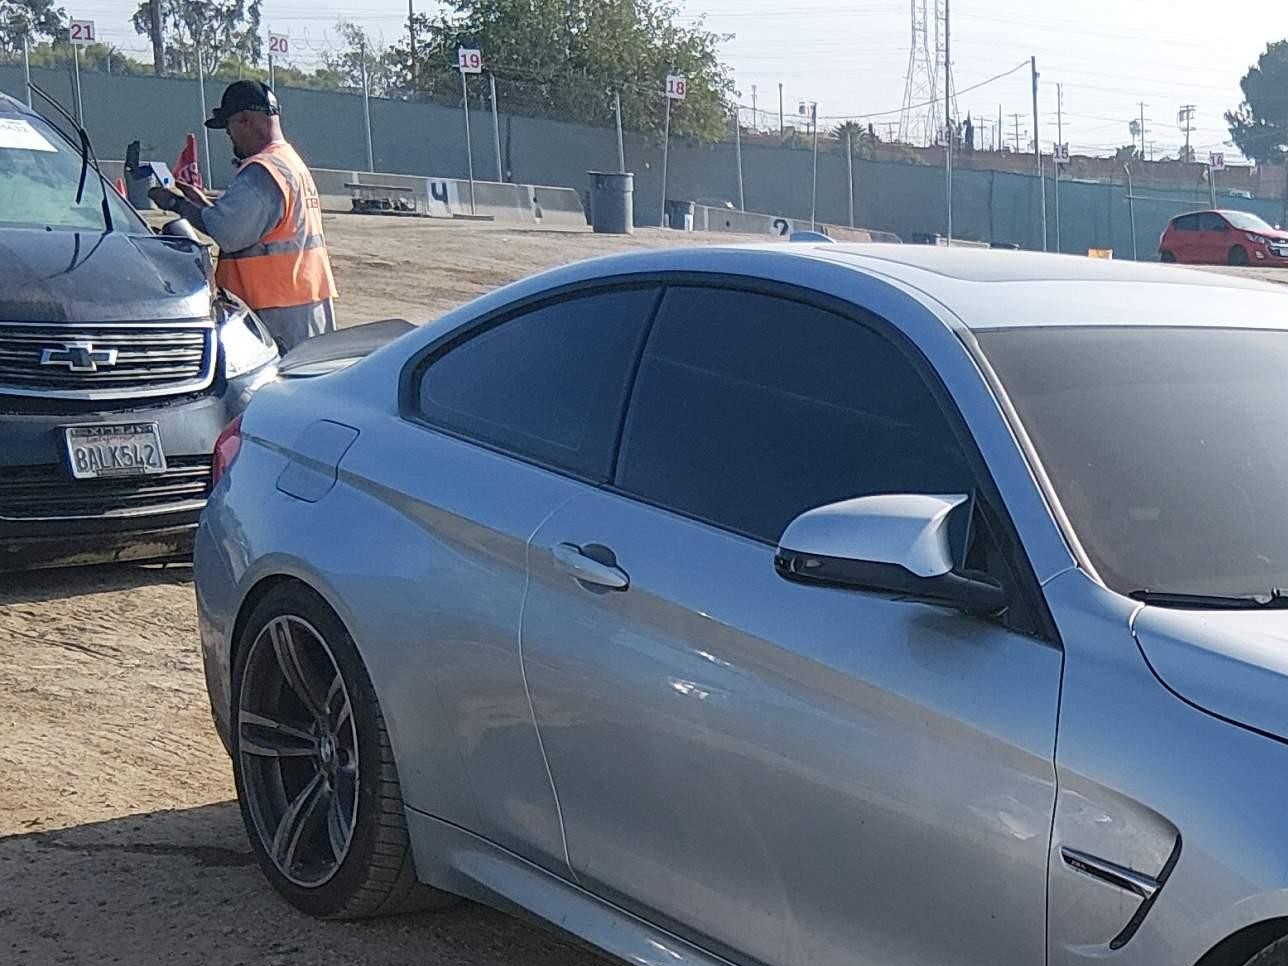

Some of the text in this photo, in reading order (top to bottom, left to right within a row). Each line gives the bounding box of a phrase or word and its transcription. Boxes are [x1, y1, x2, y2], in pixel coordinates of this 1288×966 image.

[71, 24, 95, 40] 21
[270, 36, 288, 53] 20
[460, 53, 480, 68] 19
[667, 80, 685, 95] 18
[1055, 148, 1069, 160] 15
[1210, 154, 1225, 168] 14
[75, 444, 157, 473] 8ALK542
